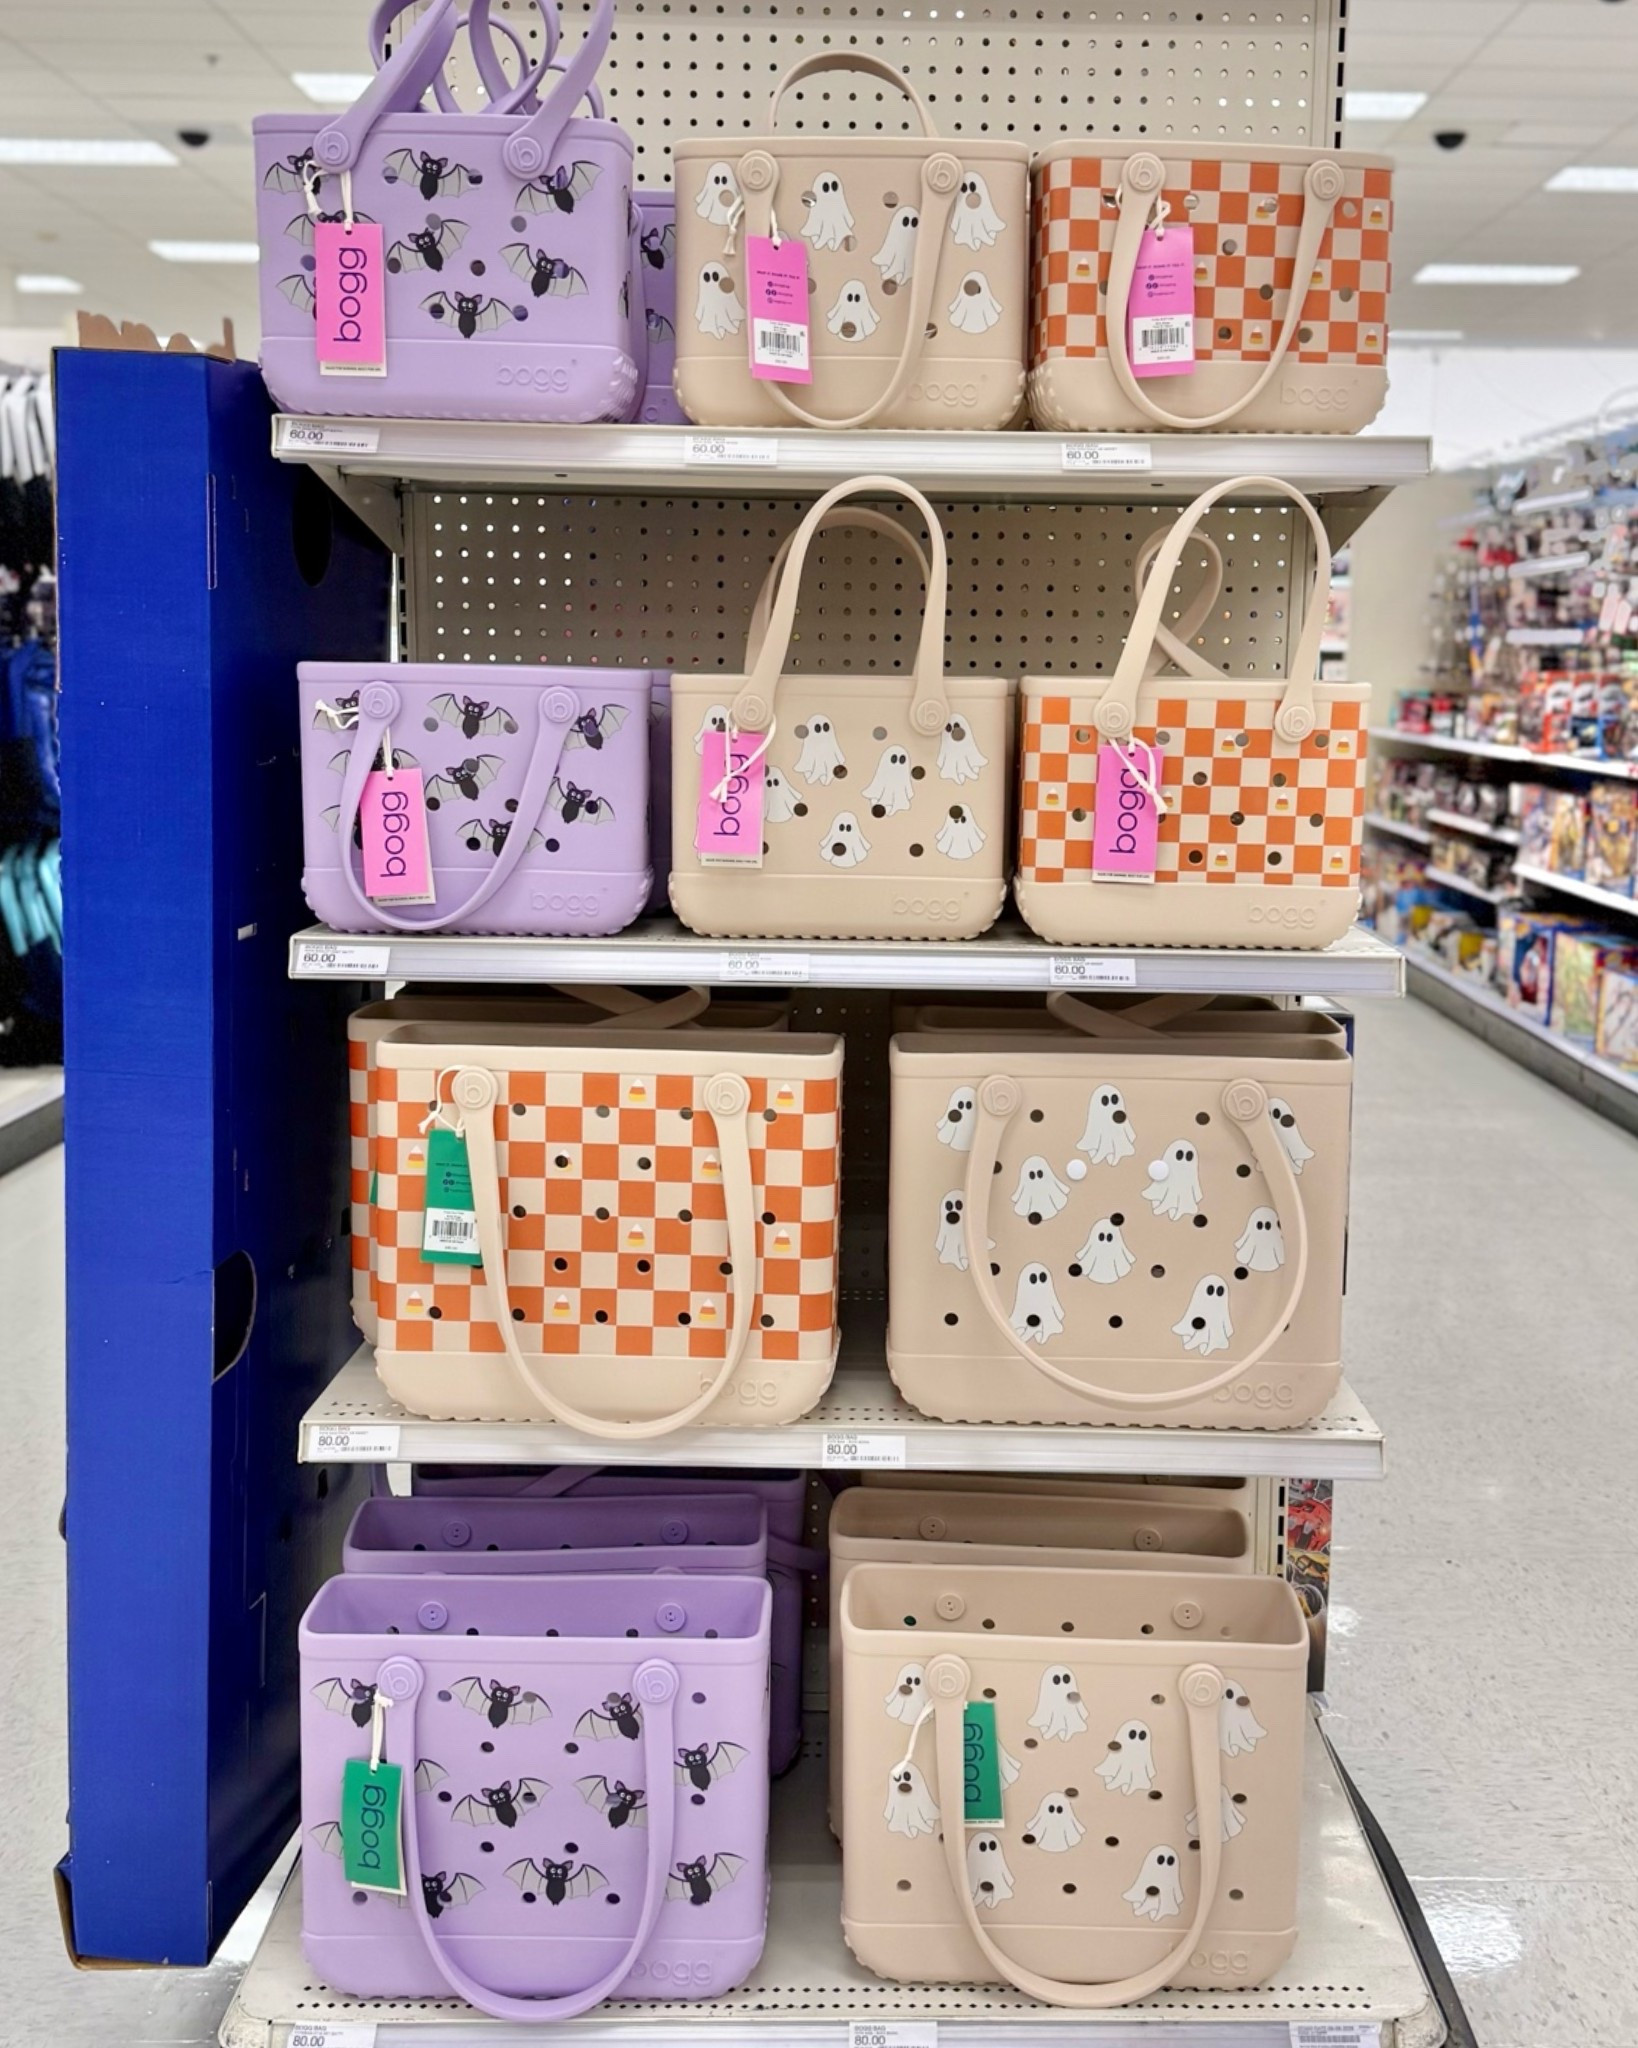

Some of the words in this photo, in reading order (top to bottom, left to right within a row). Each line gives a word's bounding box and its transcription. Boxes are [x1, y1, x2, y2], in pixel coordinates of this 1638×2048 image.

[333, 247, 367, 342] bogg
[497, 361, 570, 392] bogg
[1280, 380, 1352, 411] bogg
[289, 429, 323, 441] 60.00
[692, 443, 725, 453] 60.00
[1066, 450, 1099, 460] 60.00
[1108, 768, 1148, 854] bogg
[380, 791, 410, 878] bogg
[530, 887, 600, 917] bogg
[893, 893, 962, 921] bogg
[1248, 899, 1318, 929] bogg
[303, 952, 336, 962] 60.00
[1054, 965, 1086, 975] 60.00
[318, 1435, 350, 1446] 80.00
[827, 1444, 858, 1455] 80.00
[357, 1784, 387, 1870] bogg
[292, 2035, 325, 2047] 80.00
[854, 2035, 886, 2047] 80.00
